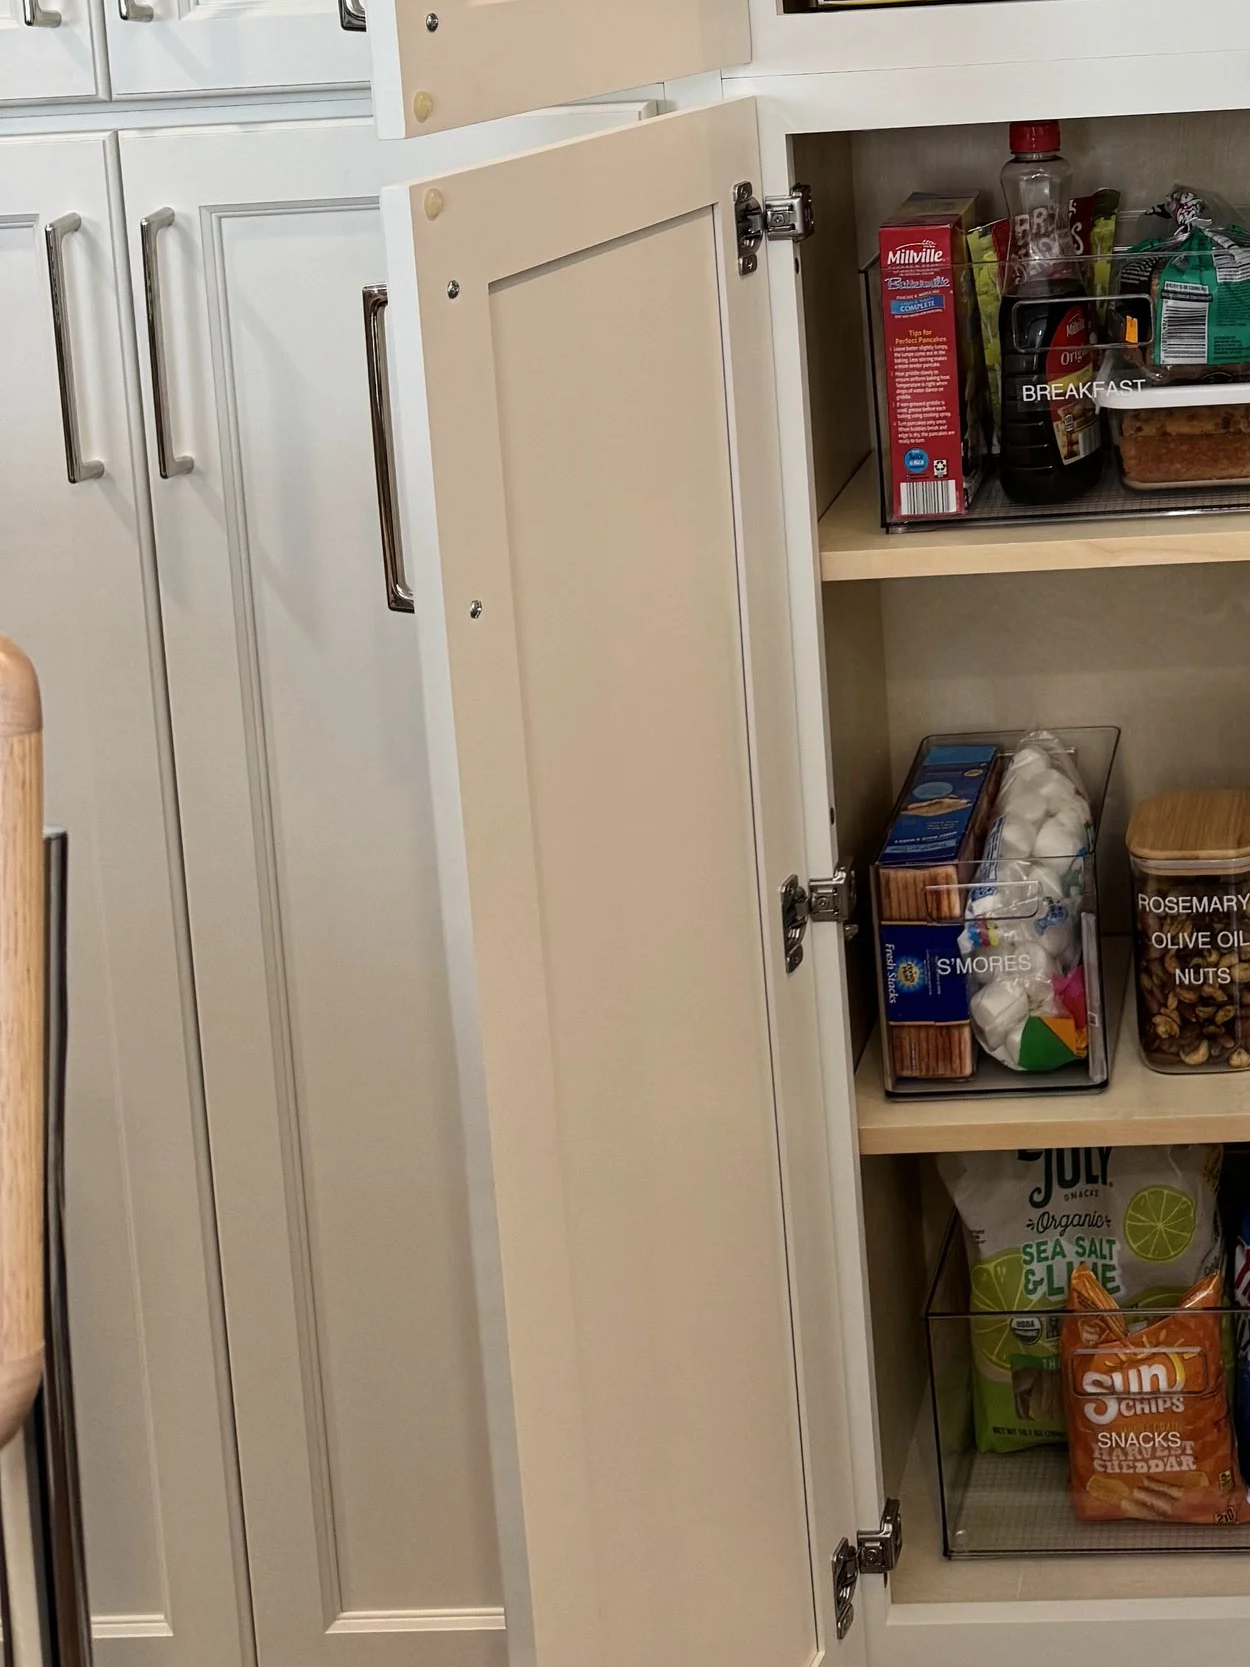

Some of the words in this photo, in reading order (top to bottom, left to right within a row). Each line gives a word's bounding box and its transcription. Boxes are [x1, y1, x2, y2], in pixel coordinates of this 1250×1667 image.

[887, 248, 944, 264] Millville
[908, 329, 922, 337] Tips
[1022, 378, 1146, 402] BREAKFAST
[1138, 893, 1250, 914] ROSEMARY
[1151, 931, 1210, 951] OLIVE
[1216, 929, 1250, 948] OIL
[885, 943, 897, 971] Fresh
[937, 954, 1032, 976] S'MORES
[887, 970, 899, 1004] Stacks
[1175, 967, 1231, 985] NUTS
[1063, 1189, 1099, 1201] SNACKS
[1037, 1210, 1105, 1237] Organic
[1022, 1238, 1067, 1266] SEA
[1074, 1235, 1116, 1261] SALT
[1082, 1363, 1169, 1425] Sun
[1119, 1395, 1185, 1417] CHIPS
[1093, 1440, 1195, 1461] HARVEST
[1097, 1431, 1181, 1448] SNACKS
[1092, 1455, 1197, 1474] CHEDDAR
